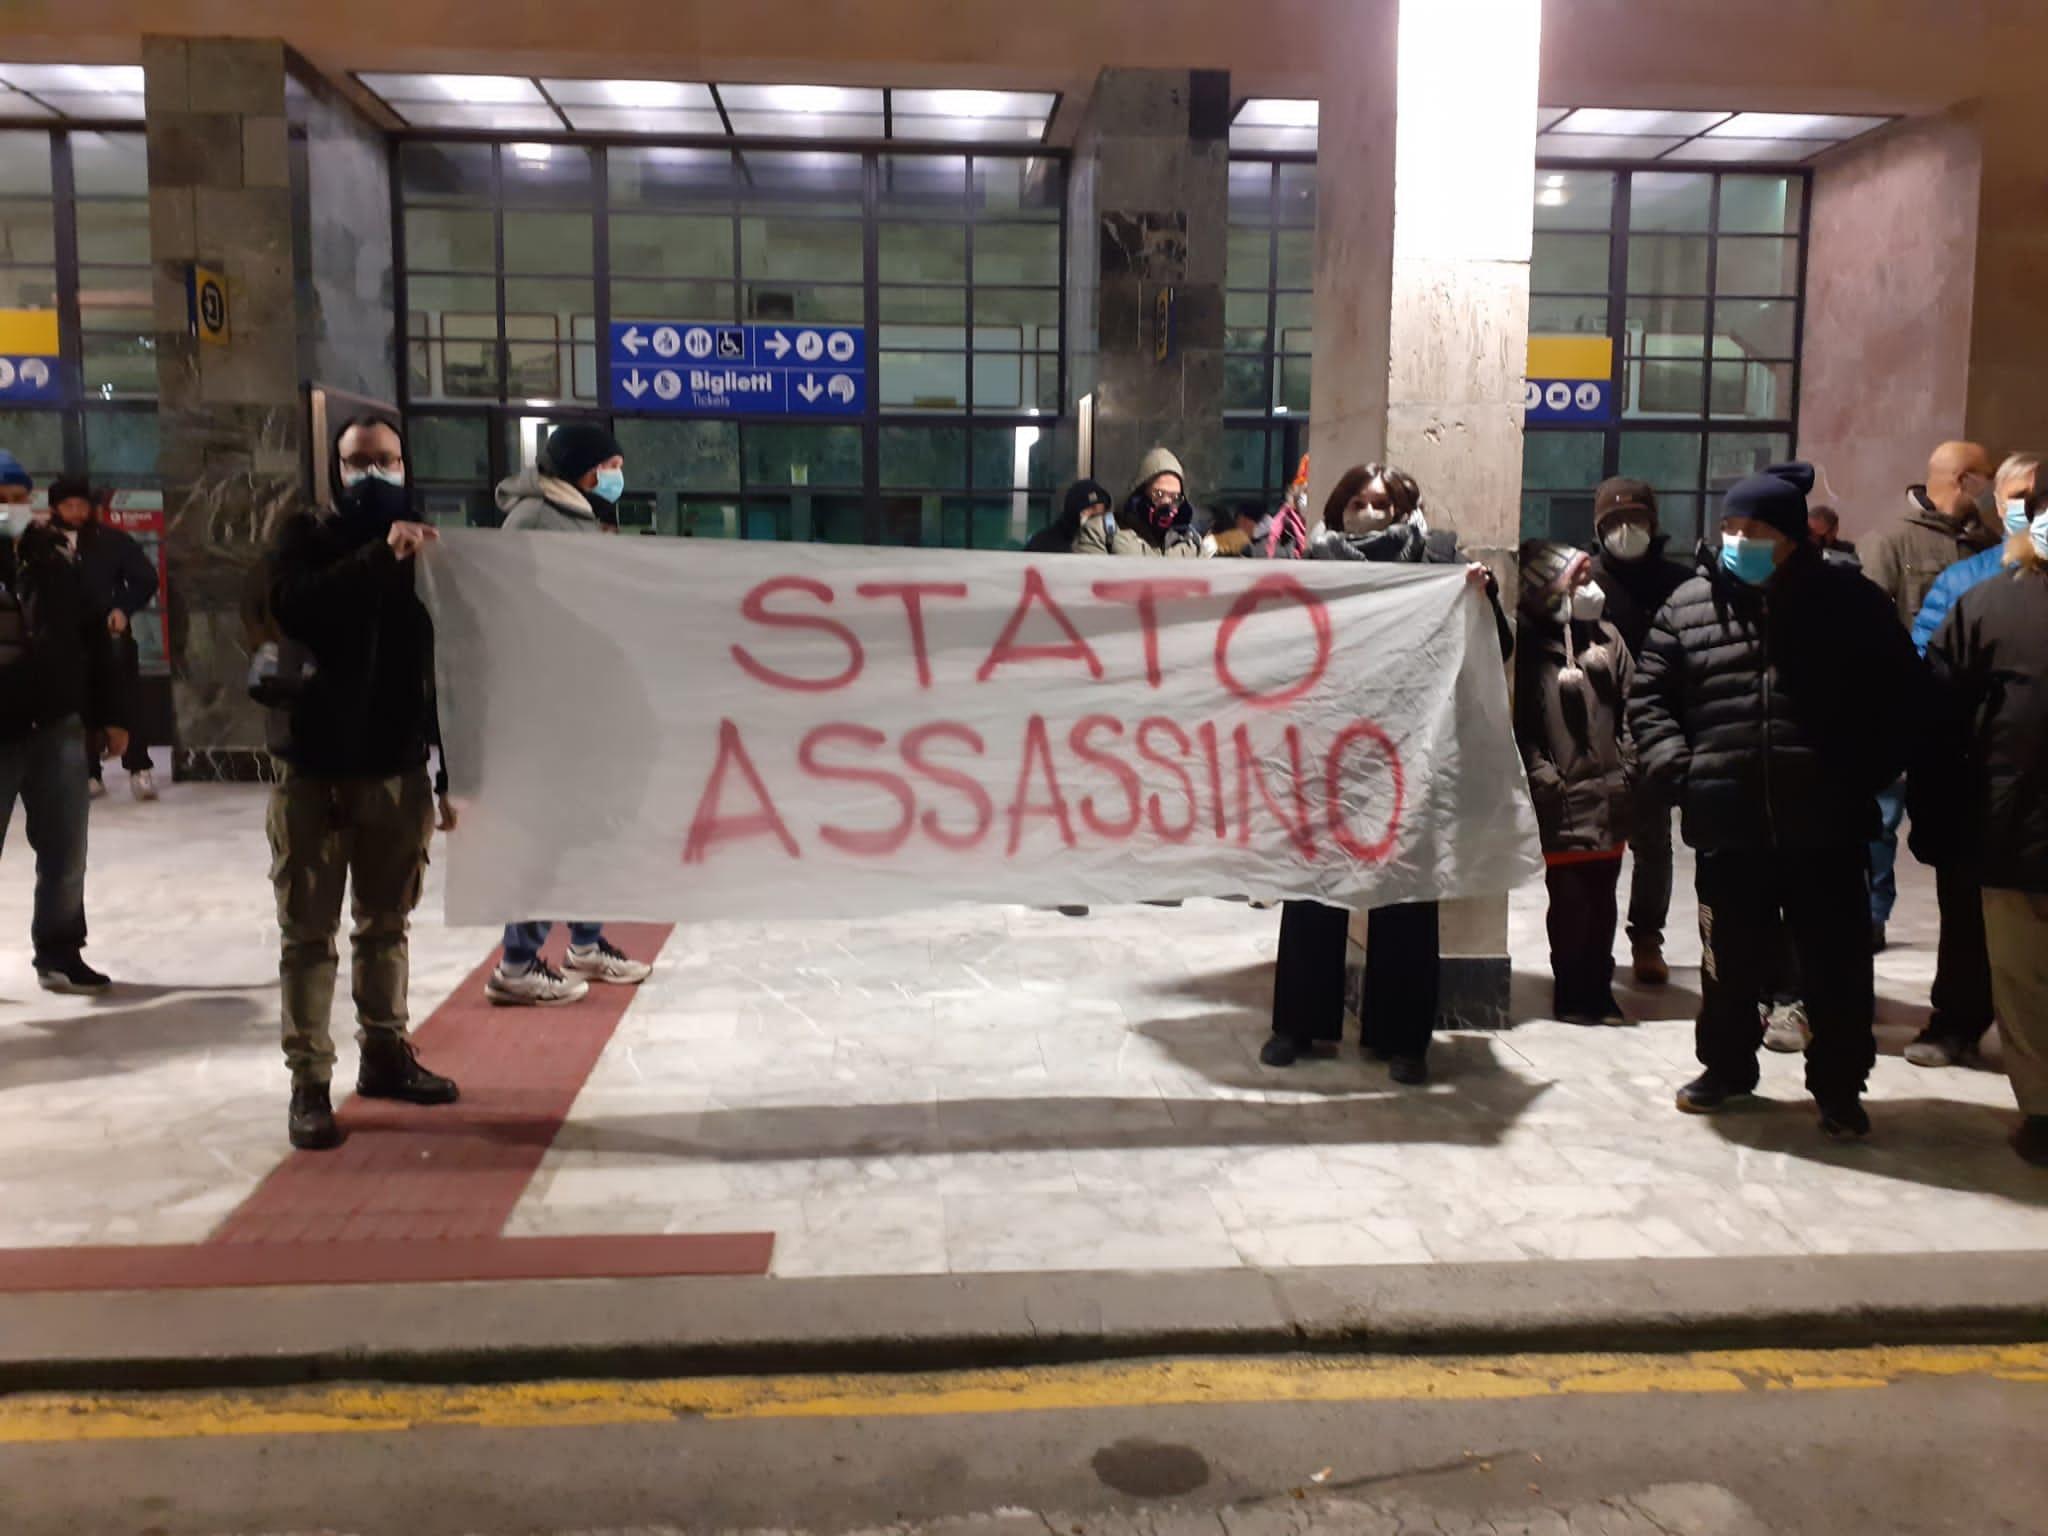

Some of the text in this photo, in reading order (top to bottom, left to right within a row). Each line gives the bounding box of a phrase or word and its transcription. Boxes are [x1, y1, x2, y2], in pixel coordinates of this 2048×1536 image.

[690, 369, 772, 395] Biglietti
[692, 392, 730, 408] Tickets
[730, 566, 1332, 708] STATO
[683, 714, 1405, 862] ASSASSINO
